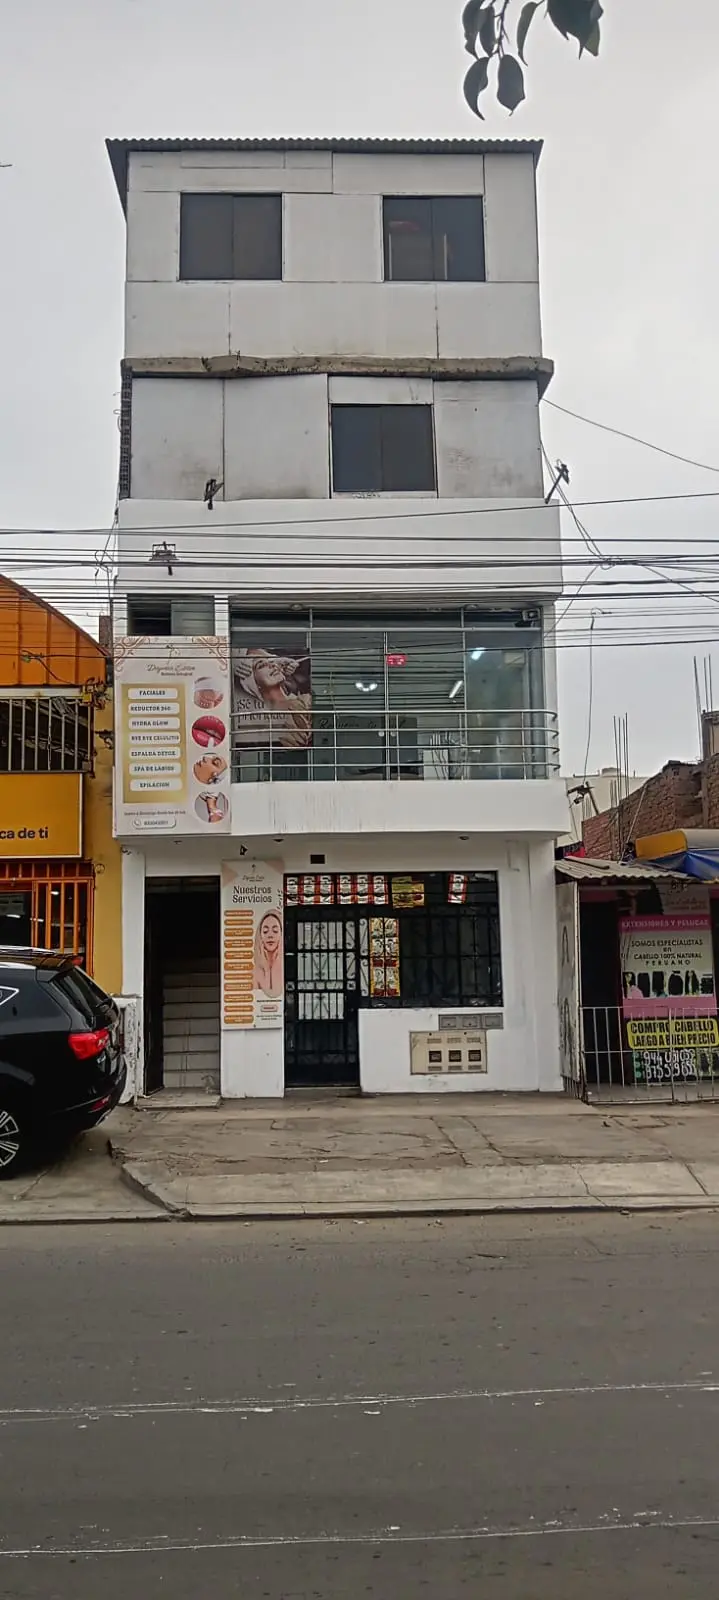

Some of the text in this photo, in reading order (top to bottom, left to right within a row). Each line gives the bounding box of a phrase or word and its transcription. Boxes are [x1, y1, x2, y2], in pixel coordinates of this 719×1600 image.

[254, 699, 265, 709] tu
[0, 827, 48, 839] ca de ti
[233, 885, 272, 894] Nuestros
[232, 894, 272, 904] Servicios
[677, 919, 708, 927] PELUCAS
[630, 1020, 714, 1034] COMPRO CABELLO
[658, 1034, 665, 1046] A
[687, 1032, 716, 1045] PRECIO
